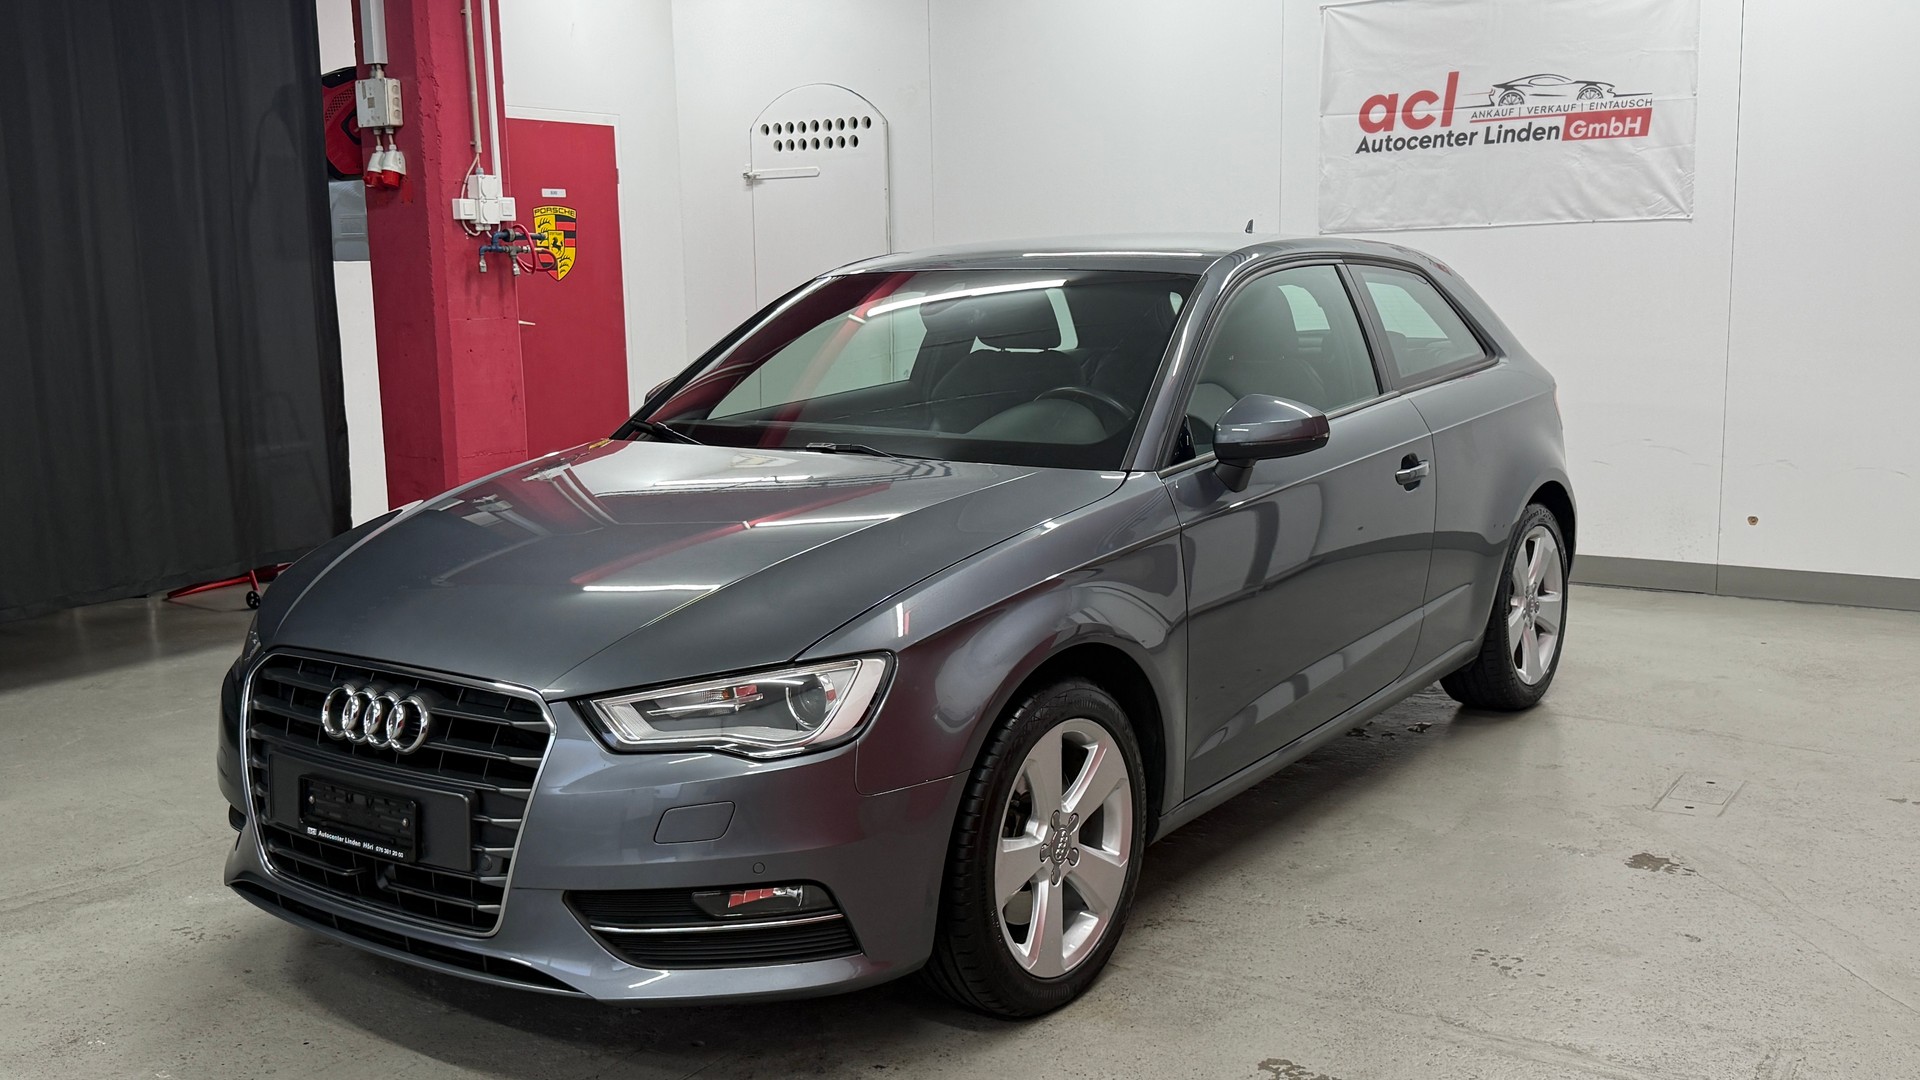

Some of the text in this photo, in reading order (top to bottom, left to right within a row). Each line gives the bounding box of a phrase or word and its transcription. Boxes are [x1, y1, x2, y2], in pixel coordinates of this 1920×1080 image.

[1358, 71, 1460, 134] acl
[1470, 98, 1654, 120] ANKAUF VERKAUF EINTAUSCH
[1355, 116, 1642, 154] Autocenter Linden GmbH
[534, 206, 575, 217] PORSCHE
[318, 830, 344, 843] Autocenter
[344, 837, 361, 847] Linden
